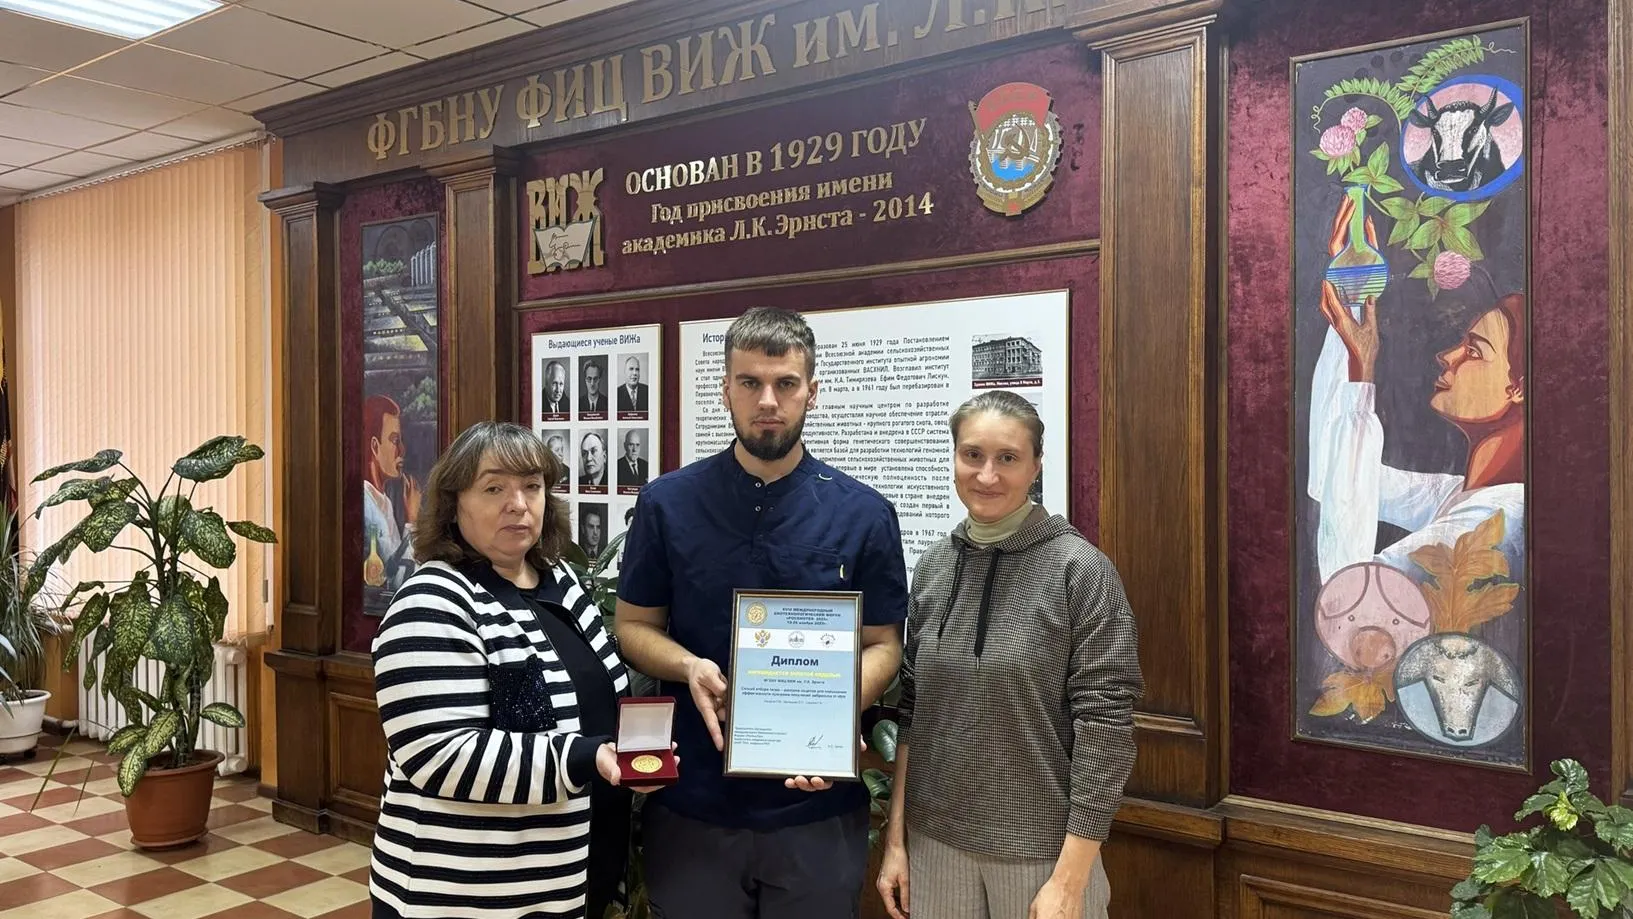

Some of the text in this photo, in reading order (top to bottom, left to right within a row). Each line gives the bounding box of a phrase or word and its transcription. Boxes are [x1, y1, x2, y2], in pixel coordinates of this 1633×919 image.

[367, 84, 504, 161] ФГБНУ
[516, 54, 627, 129] ФИЦ
[640, 14, 776, 104] ВИЖ
[793, 2, 899, 68] им.
[625, 117, 928, 195] ОСНОВАН В 1929 ГОДУ
[650, 170, 894, 226] Год присвоения имени
[621, 224, 726, 256] академика
[774, 207, 853, 239] Эрнста
[873, 190, 935, 223] 2014
[548, 334, 641, 350] Выдающиеся ученые ВИЖа
[870, 338, 883, 346] 1929
[916, 400, 950, 408] разработке
[910, 427, 926, 435] СССР
[922, 529, 935, 537] 1967
[770, 655, 820, 667] Диплом
